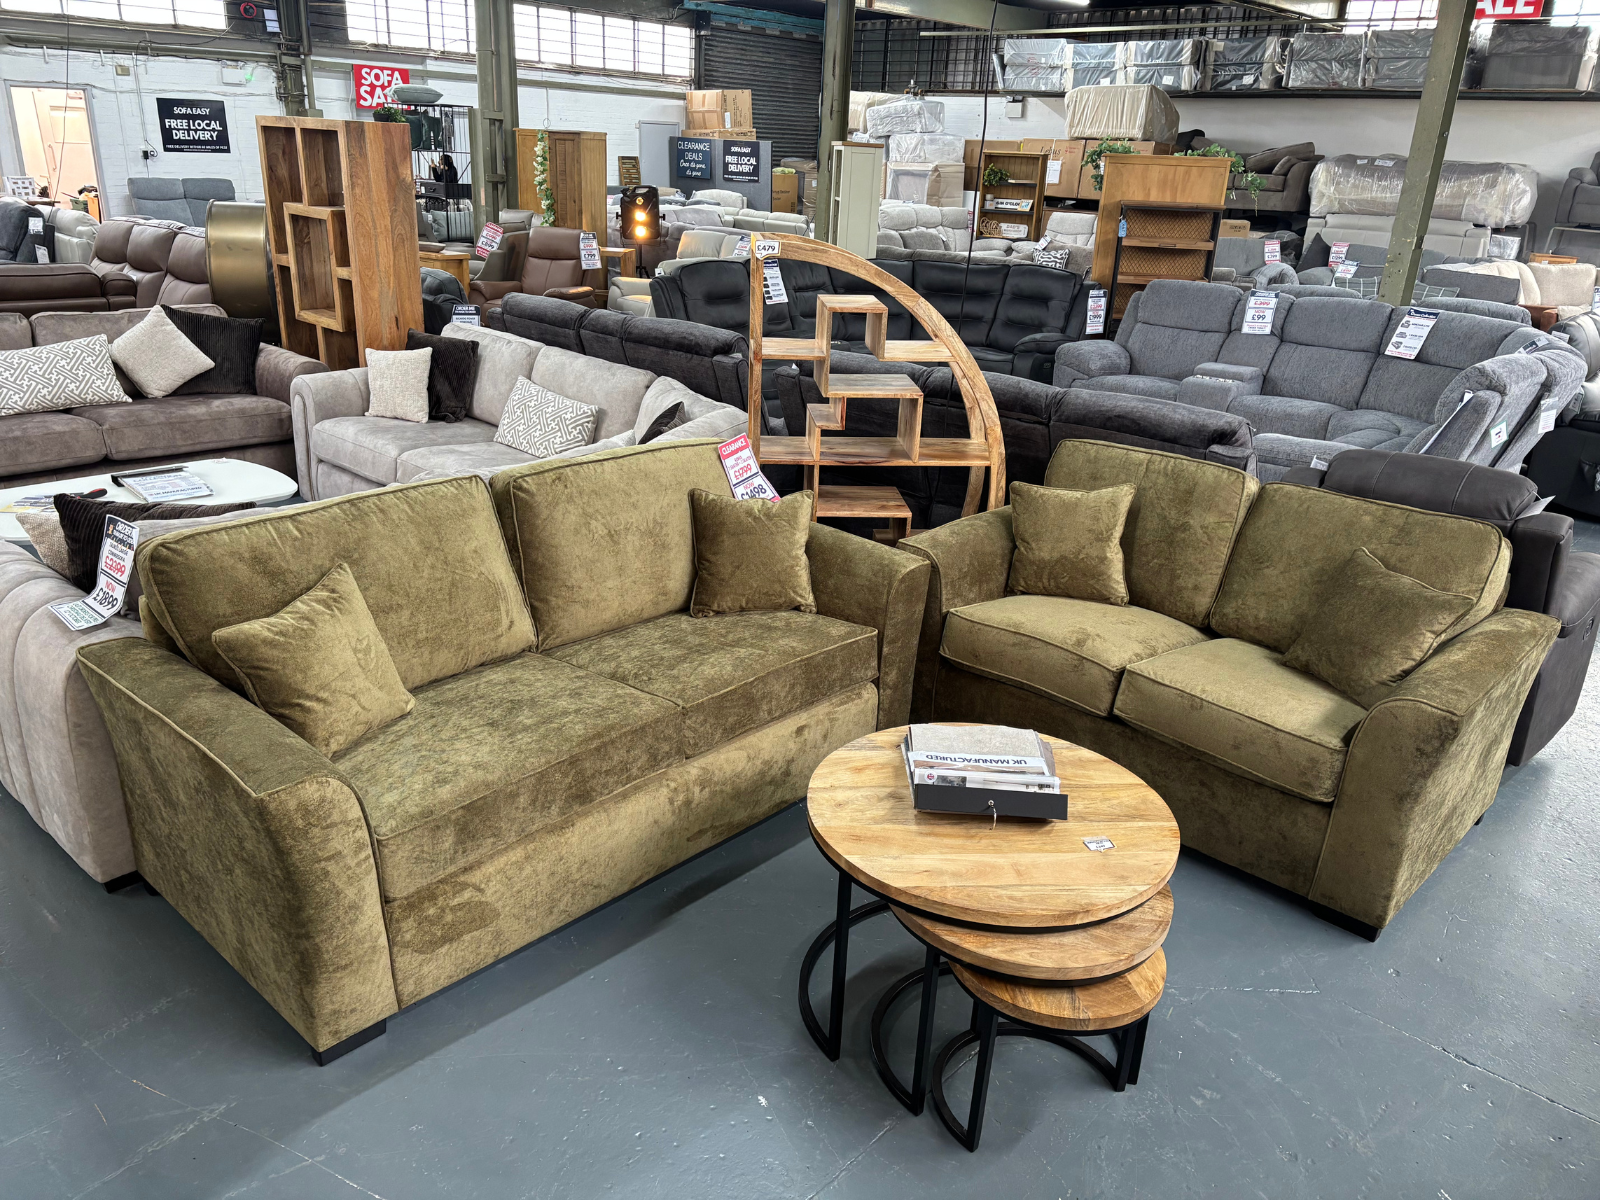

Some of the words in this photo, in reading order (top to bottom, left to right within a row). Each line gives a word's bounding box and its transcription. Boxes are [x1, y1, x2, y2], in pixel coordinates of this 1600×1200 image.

[1475, 0, 1535, 14] ALE
[361, 67, 403, 87] SOFA
[173, 106, 193, 115] SOFA
[192, 107, 210, 116] EASY
[165, 118, 189, 130] FREE
[189, 119, 223, 131] LOCAL
[172, 130, 218, 141] DELIVERY
[677, 141, 711, 152] CLEARANCE
[684, 151, 703, 161] DEALS
[725, 155, 738, 164] FREE
[738, 156, 757, 165] LOCAL
[679, 160, 690, 168] Once
[728, 164, 754, 173] DELIVERY
[756, 244, 776, 252] £479
[1251, 313, 1267, 321] £99
[721, 437, 747, 455] CLEARANCE
[733, 463, 753, 480] £1799
[743, 481, 755, 490] NOW
[740, 483, 767, 500] £1498
[104, 555, 126, 578] £2399
[105, 580, 116, 593] NOW
[92, 587, 119, 611] £1899
[926, 754, 1011, 765] MANUFACTURED
